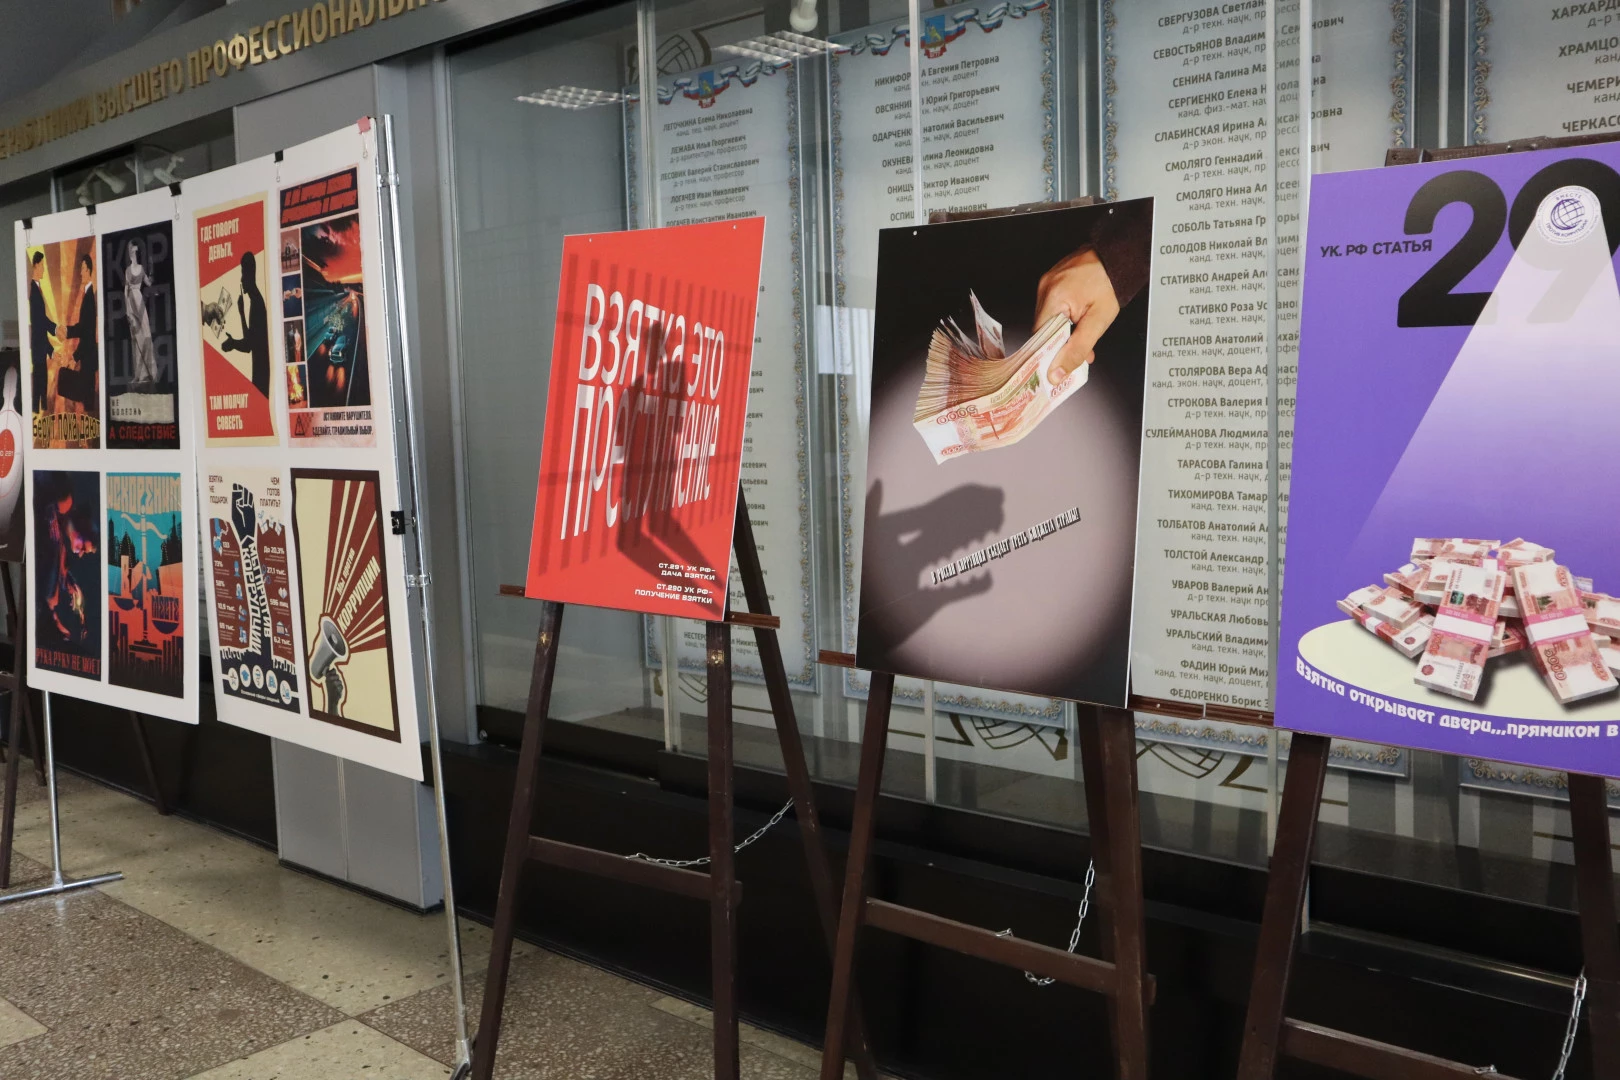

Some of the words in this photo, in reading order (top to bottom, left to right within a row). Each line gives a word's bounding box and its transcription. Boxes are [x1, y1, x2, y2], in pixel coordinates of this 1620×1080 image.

[1158, 6, 1220, 28] СВЕРГУЗОВА
[1222, 0, 1267, 14] Светлан
[1182, 23, 1200, 35] д-р
[1202, 19, 1225, 30] техн.
[1227, 13, 1252, 25] наук,
[1153, 38, 1223, 60] СЕВОСТЬЯНОВ
[1225, 31, 1267, 47] Владим
[97, 59, 183, 124] ВЫСШЕГО
[187, 0, 450, 89] ПРОФЕССИОНАЛЬ
[875, 69, 926, 87] НИКИФОРА
[928, 63, 960, 77] Евгения
[960, 54, 1000, 71] Петровна
[952, 69, 979, 84] доцент
[1172, 72, 1212, 88] СЕНИНА
[1214, 66, 1250, 80] Галина
[925, 93, 948, 108] Юрий
[949, 83, 1000, 101] Григорьевич
[1168, 91, 1225, 109] СЕРГИЕНКО
[1227, 87, 1258, 99] Елена
[697, 116, 716, 125] Елена
[716, 107, 753, 120] Николаевна
[1178, 108, 1201, 119] канд.
[1204, 100, 1250, 116] физ.-мат.
[956, 112, 1005, 128] Васильевич
[1154, 123, 1220, 143] СЛАБИНСКАЯ
[1222, 119, 1255, 134] Ирина
[711, 134, 746, 147] Георгиевич
[1182, 140, 1200, 151] д-р
[1201, 136, 1226, 147] экон.
[1228, 131, 1252, 143] наук,
[944, 143, 994, 159] Леонидовна
[687, 165, 712, 177] Валерий
[713, 158, 760, 172] Станиславович
[1165, 156, 1212, 172] СМОЛЯГО
[1214, 149, 1263, 165] Геннадий
[950, 173, 990, 186] Иванович
[696, 190, 712, 199] Иван
[712, 185, 750, 196] Николаевич
[1176, 188, 1224, 202] СМОЛЯГО
[1225, 184, 1252, 196] Нина
[1189, 201, 1213, 212] канд.
[1215, 198, 1238, 208] техн.
[1241, 195, 1266, 207] наук,
[726, 210, 757, 220] Иванович
[200, 225, 212, 243] ГДЕ
[212, 217, 239, 240] ГОВОРЯТ
[1171, 221, 1211, 234] СОБОЛЬ
[1213, 218, 1253, 230] Татьяна
[1159, 241, 1207, 255] СОЛОДОВ
[1208, 237, 1253, 250] Николай
[1320, 245, 1343, 258] УК.
[1345, 243, 1368, 257] РФ
[1372, 239, 1433, 255] СТАТЬЯ
[1160, 273, 1209, 286] СТАТИВКО
[1211, 269, 1250, 283] Андрей
[1178, 303, 1228, 315] СТАТИВКО
[1230, 302, 1254, 313] Роза
[1162, 336, 1213, 347] СТЕПАНОВ
[1214, 333, 1264, 345] Анатолий
[1152, 350, 1176, 358] канд.
[1177, 348, 1200, 357] техн.
[1201, 347, 1225, 358] наук,
[1227, 346, 1263, 357] доцент,
[1168, 366, 1226, 377] СТОЛЯРОВА
[1228, 366, 1253, 377] Вера
[209, 395, 223, 410] ТАМ
[222, 393, 249, 410] МОЛЧИТ
[1167, 398, 1218, 408] СТРОКОВА
[1219, 397, 1263, 408] Валерия
[216, 414, 244, 431] СОВЕСТЬ
[1184, 410, 1202, 420] д-р
[1203, 409, 1226, 418] техн.
[1228, 409, 1252, 419] наук,
[109, 425, 116, 440] А
[119, 424, 177, 441] СЛЕДСТВИЕ
[1145, 427, 1217, 438] СУЛЕЙМАНОВА
[1218, 429, 1268, 439] Людмила
[1177, 459, 1226, 469] ТАРАСОВА
[1228, 460, 1263, 470] Галина
[266, 487, 281, 497] ГОТОВ
[1168, 489, 1234, 500] ТИХОМИРОВА
[1237, 491, 1268, 503] Тамар
[1157, 519, 1206, 530] ТОЛБАТОВ
[1208, 521, 1256, 533] Анатолий
[1164, 549, 1207, 561] ТОЛСТОЙ
[1210, 551, 1264, 565] Александр
[658, 562, 684, 571] СТ.291
[686, 564, 697, 572] УК
[661, 570, 683, 578] ДАЧА
[684, 572, 715, 581] ВЗЯТКИ
[336, 555, 381, 634] КОРРУПЦИИ
[656, 583, 683, 592] СТ.290
[684, 586, 695, 594] УК
[1171, 579, 1209, 591] УВАРОВ
[1211, 582, 1254, 595] Валерий
[242, 547, 262, 656] КОРРУПЦИИ
[634, 589, 680, 600] ПОЛУЧЕНИЕ
[682, 594, 713, 604] ВЗЯТКИ
[254, 573, 272, 638] ПРОТИВ
[1170, 609, 1226, 623] УРАЛЬСКАЯ
[1228, 611, 1268, 626] Любовь
[1166, 628, 1223, 642] УРАЛЬСКИЙ
[1180, 659, 1216, 671] ФАДИН
[1218, 663, 1247, 676] Юрий
[1170, 687, 1229, 703] ФЕДОРЕНКО
[1231, 694, 1262, 708] Борис
[1349, 688, 1436, 724] открывает
